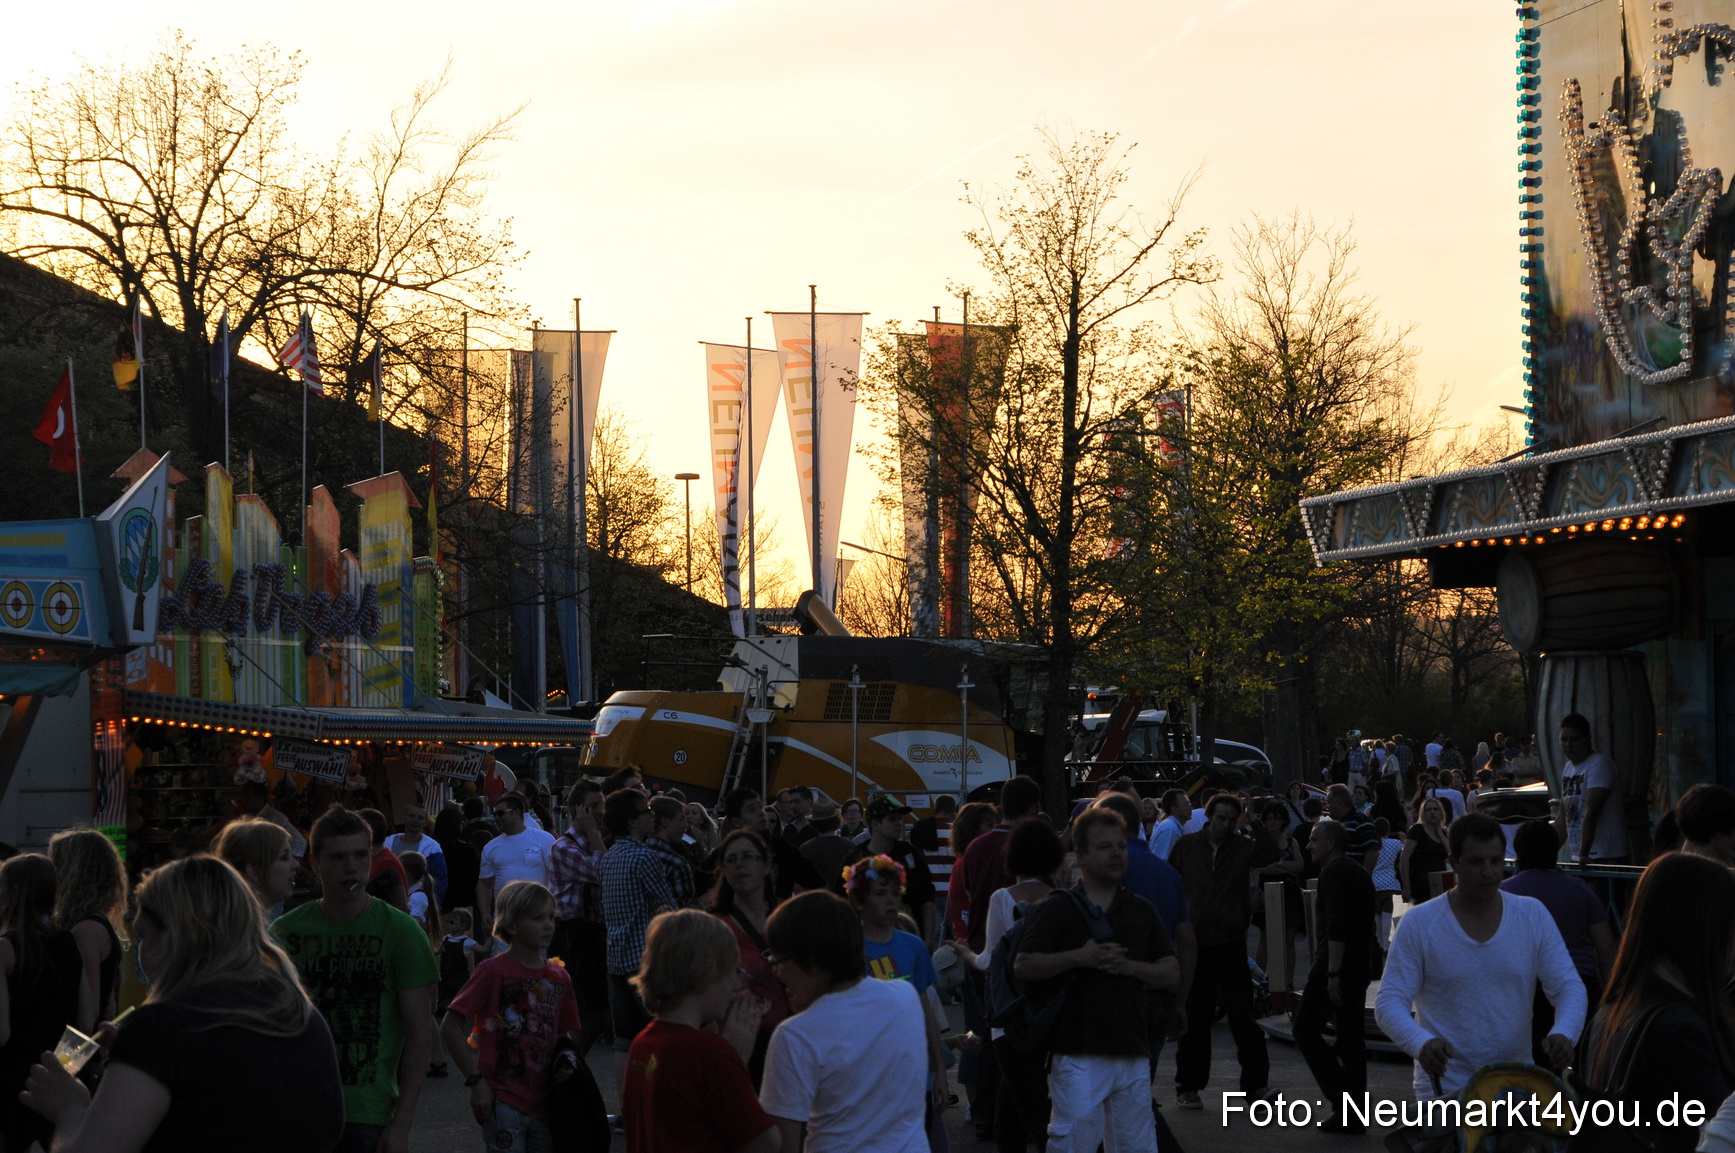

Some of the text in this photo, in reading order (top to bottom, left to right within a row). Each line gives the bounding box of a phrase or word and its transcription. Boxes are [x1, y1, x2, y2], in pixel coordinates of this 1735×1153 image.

[663, 711, 678, 720] C6
[676, 752, 685, 762] 20
[277, 752, 343, 776] FREIE AUSWAHL
[429, 759, 478, 776] AUSWAHL
